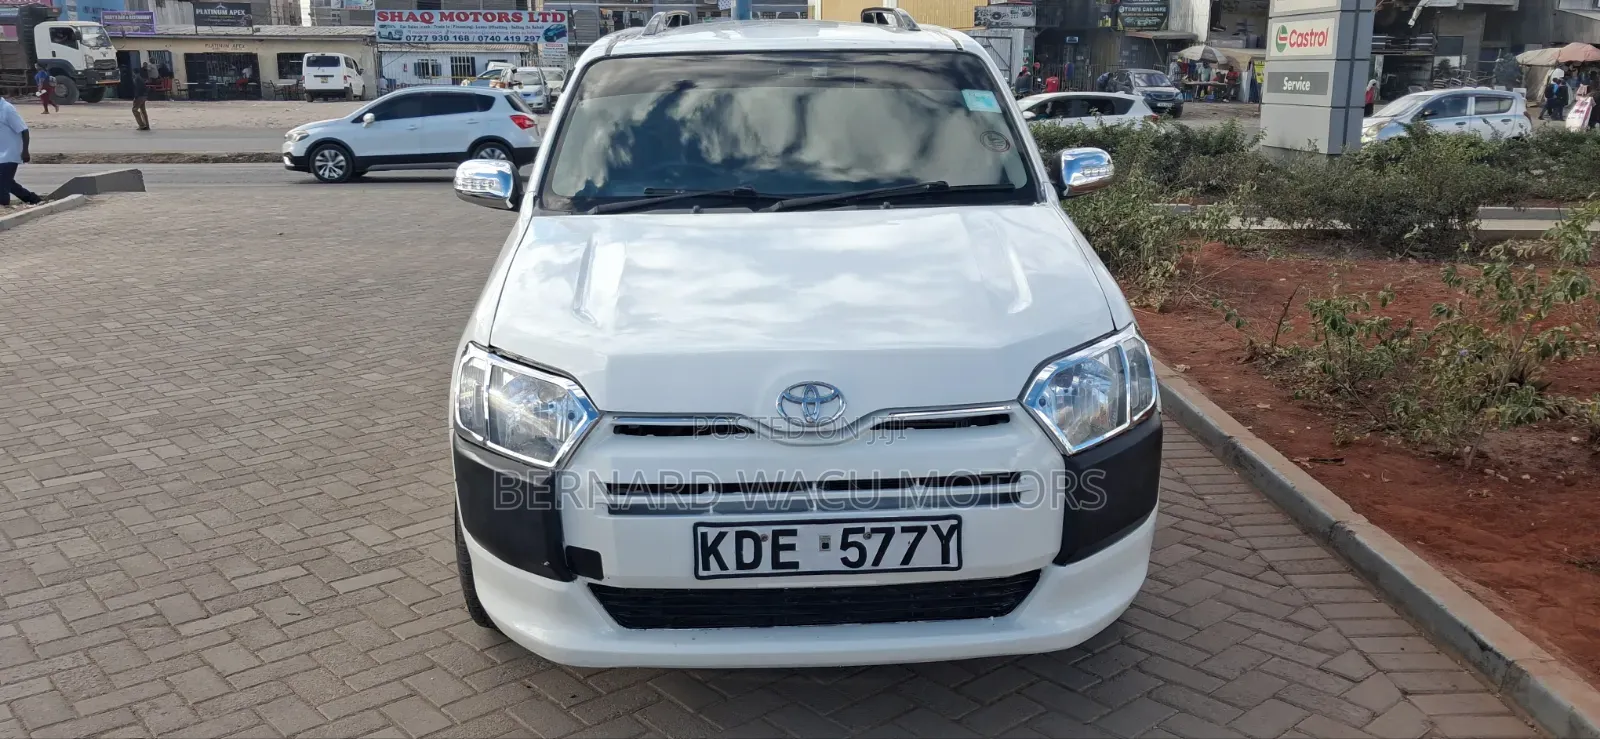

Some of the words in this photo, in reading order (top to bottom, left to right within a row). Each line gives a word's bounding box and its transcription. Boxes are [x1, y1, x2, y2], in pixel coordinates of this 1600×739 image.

[377, 11, 434, 24] SHAQ
[439, 11, 523, 23] MOTORS
[528, 11, 566, 23] LTD
[1288, 27, 1330, 48] Castrol
[1282, 76, 1311, 91] Service
[700, 528, 800, 571] KDE
[839, 523, 958, 569] 577Y
